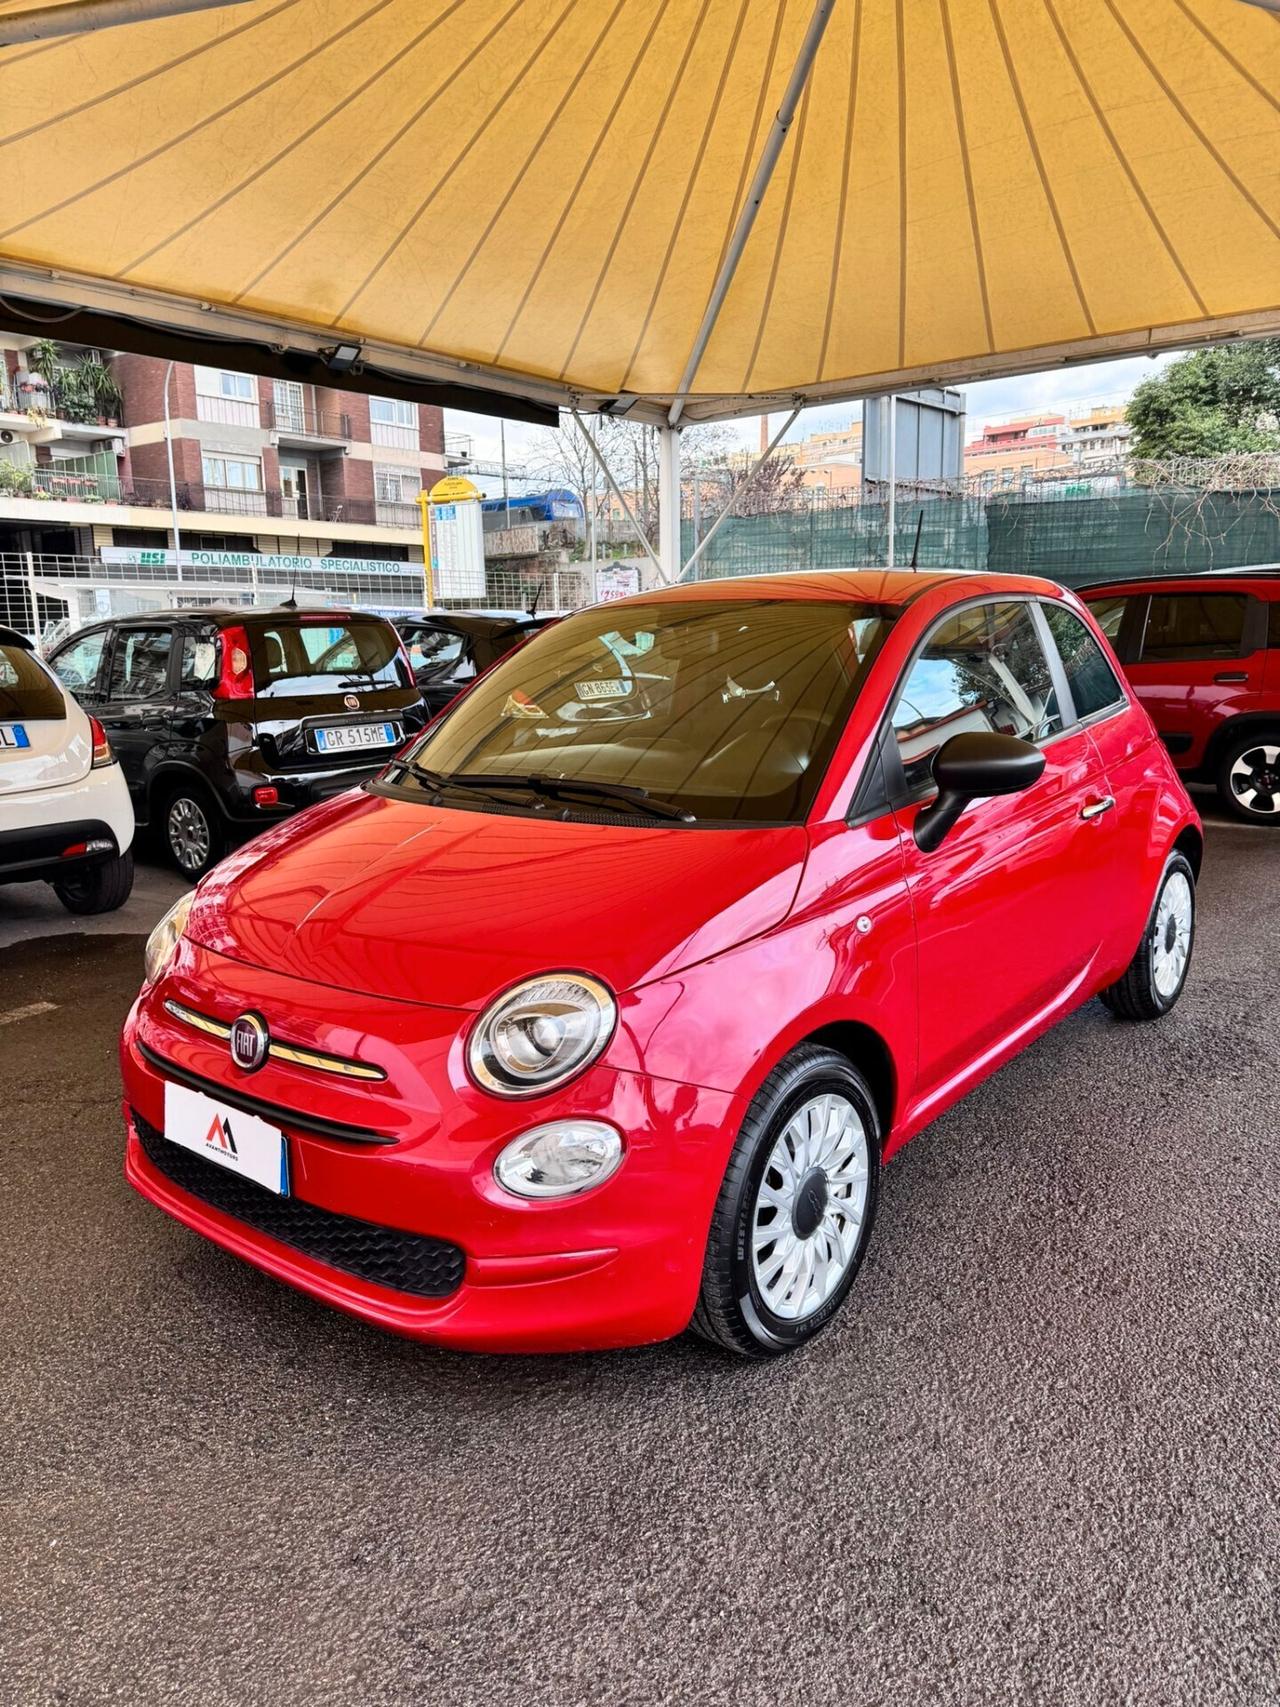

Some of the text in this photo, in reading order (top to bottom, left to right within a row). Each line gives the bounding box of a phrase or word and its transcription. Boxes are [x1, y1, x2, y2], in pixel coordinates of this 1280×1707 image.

[191, 552, 400, 573] POLIAMBULATORIO SPECIALISTICO
[326, 726, 386, 747] GR 515ME
[236, 1030, 255, 1057] FIAT
